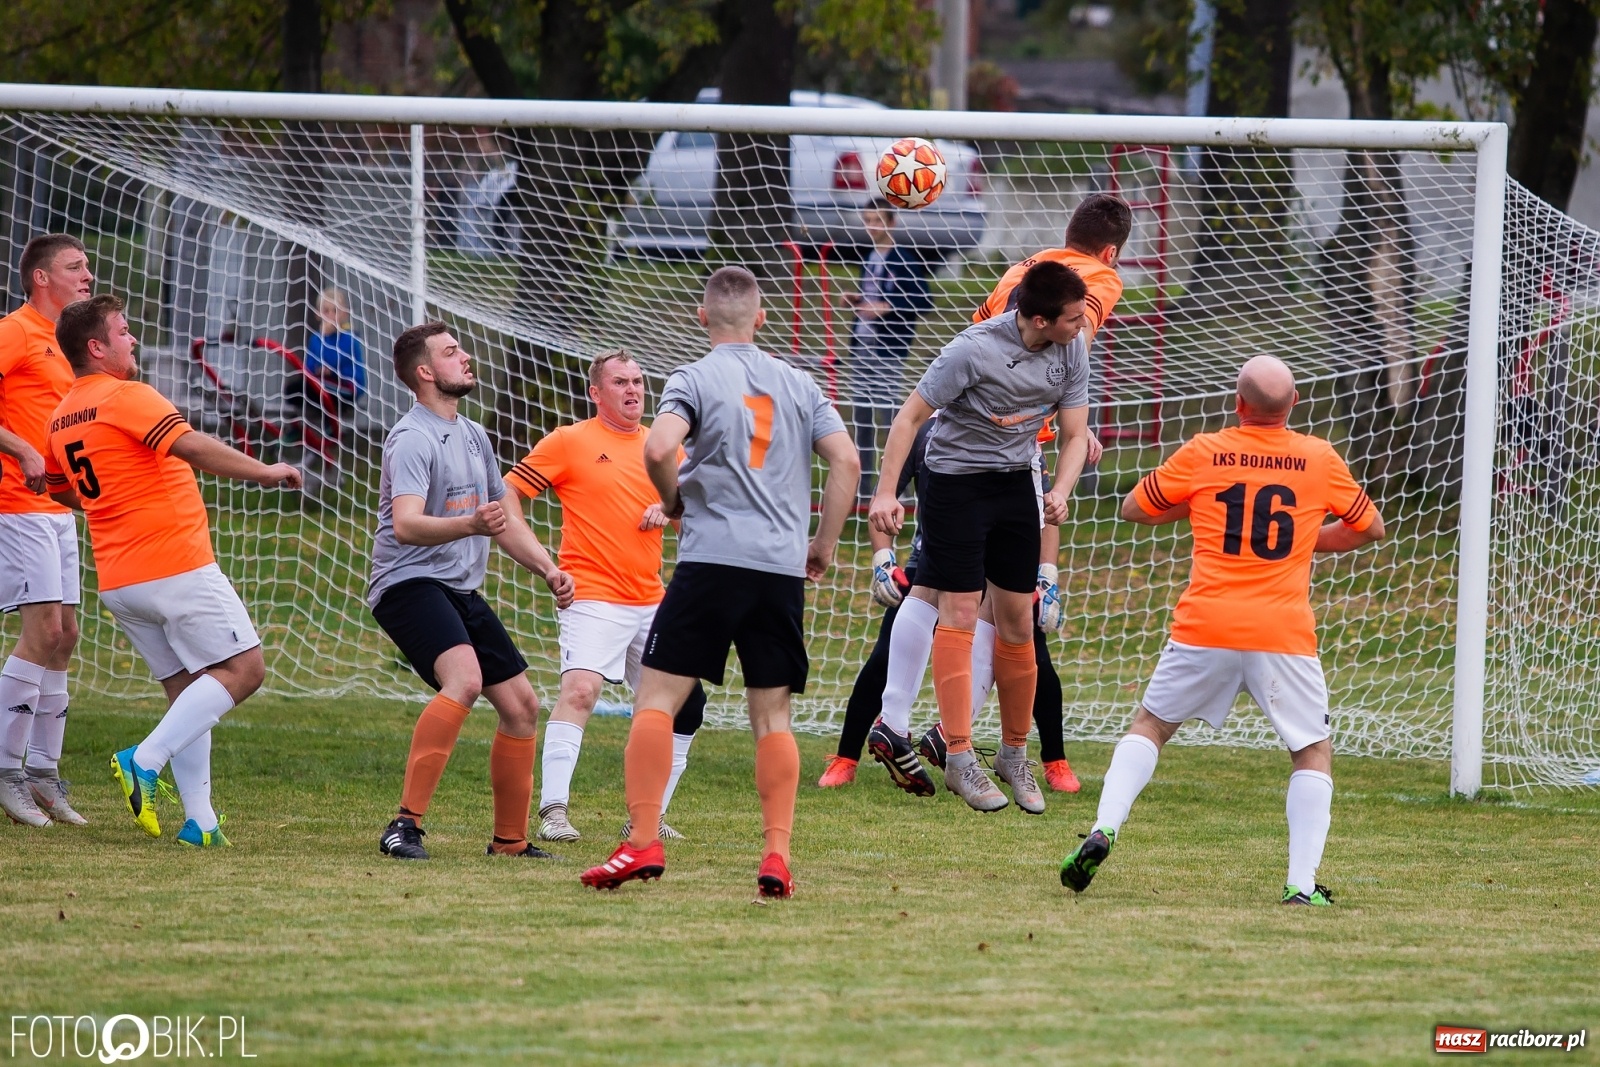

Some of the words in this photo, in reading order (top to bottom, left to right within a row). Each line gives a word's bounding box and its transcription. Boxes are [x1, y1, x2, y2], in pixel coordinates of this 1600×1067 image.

[60, 406, 98, 430] BOJANÓW
[742, 393, 775, 470] 7
[64, 439, 101, 500] 5
[1213, 452, 1236, 467] LKS
[1240, 454, 1307, 472] BOJANÓW
[1214, 482, 1297, 561] 16
